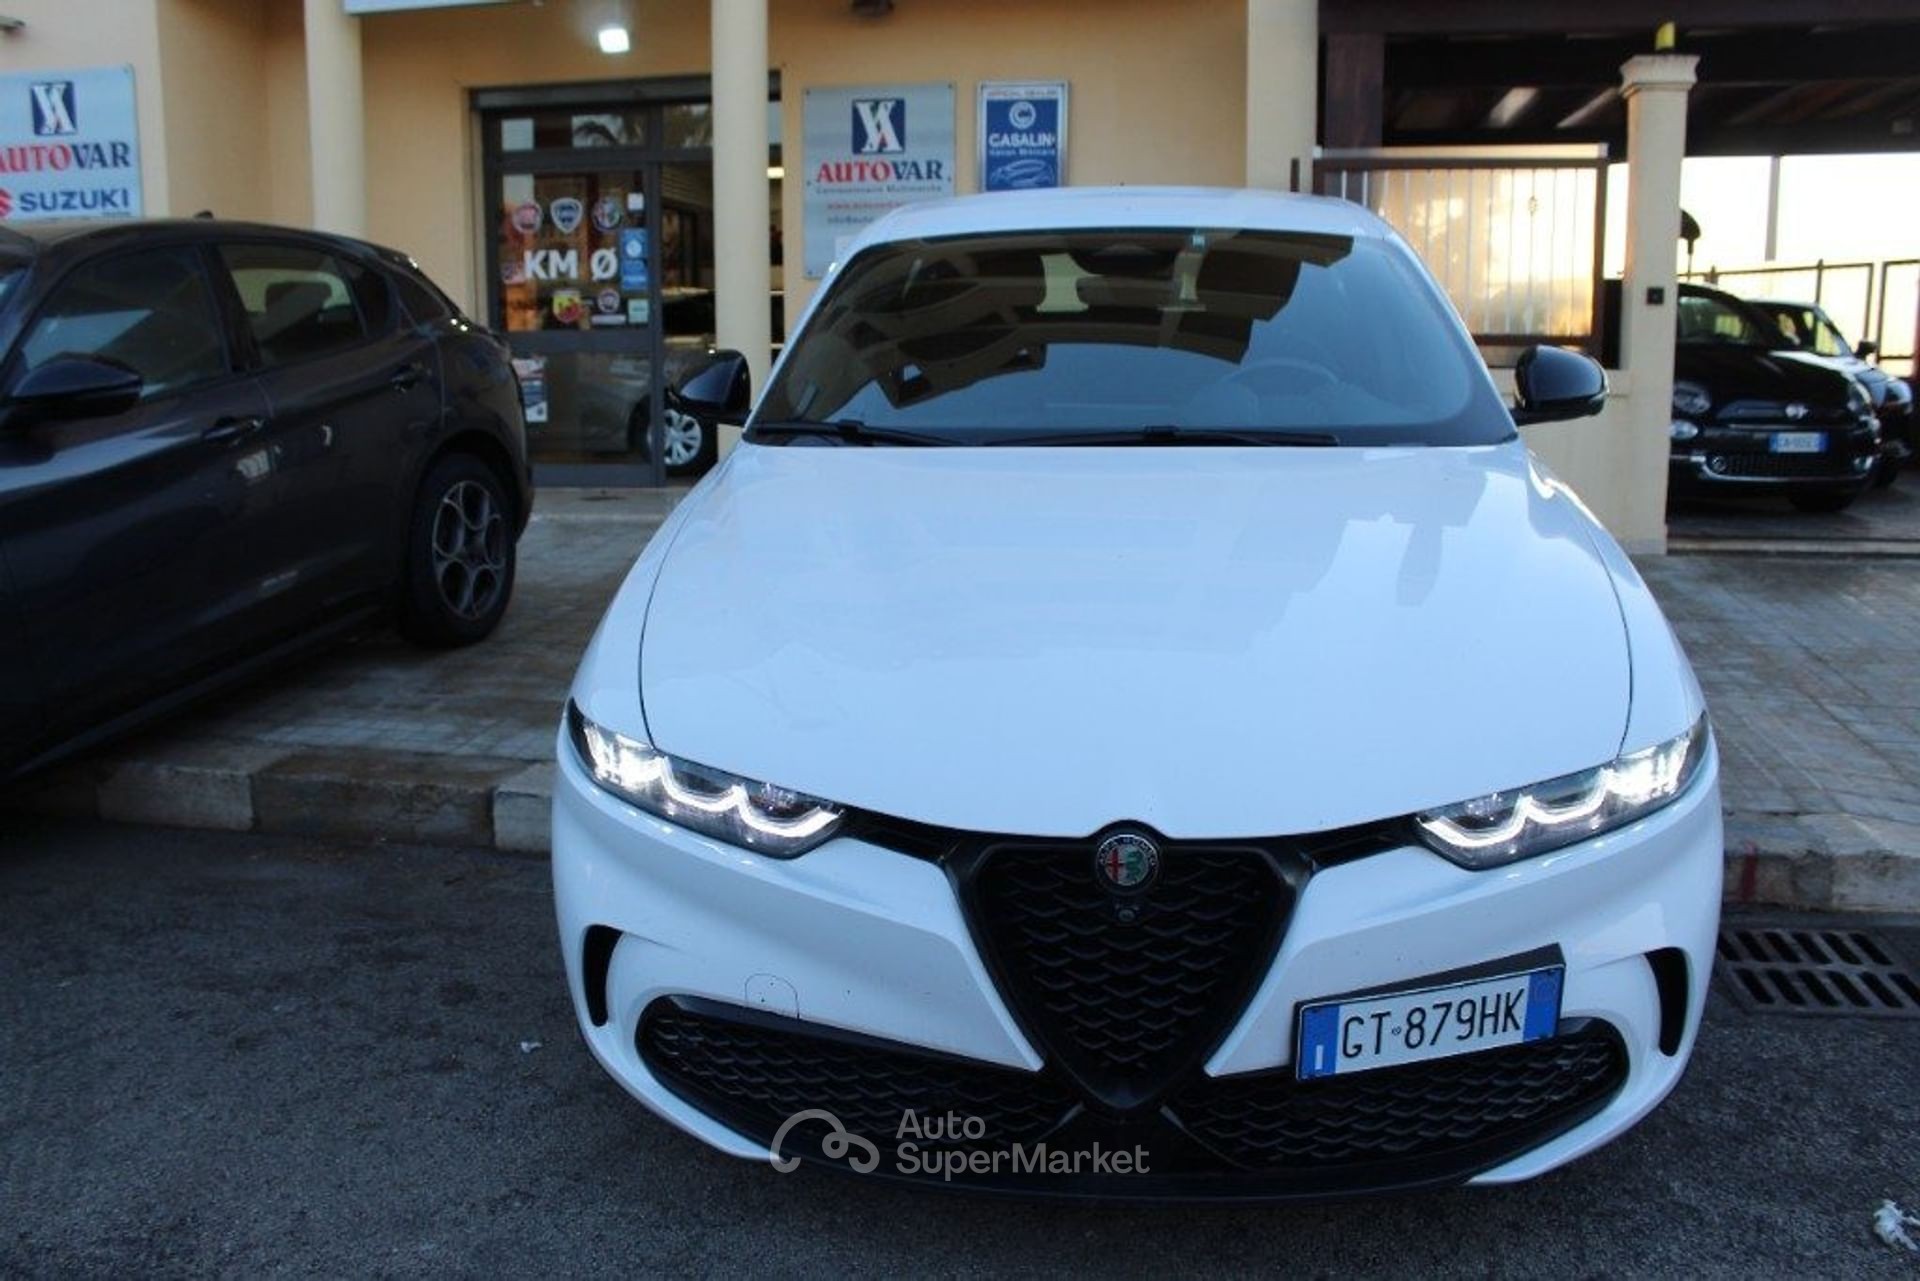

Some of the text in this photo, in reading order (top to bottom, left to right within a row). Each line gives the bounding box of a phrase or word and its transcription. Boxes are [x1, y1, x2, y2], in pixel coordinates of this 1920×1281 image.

[817, 160, 943, 183] AUTOVAR
[20, 188, 129, 212] SUZUKI
[524, 249, 578, 280] KM
